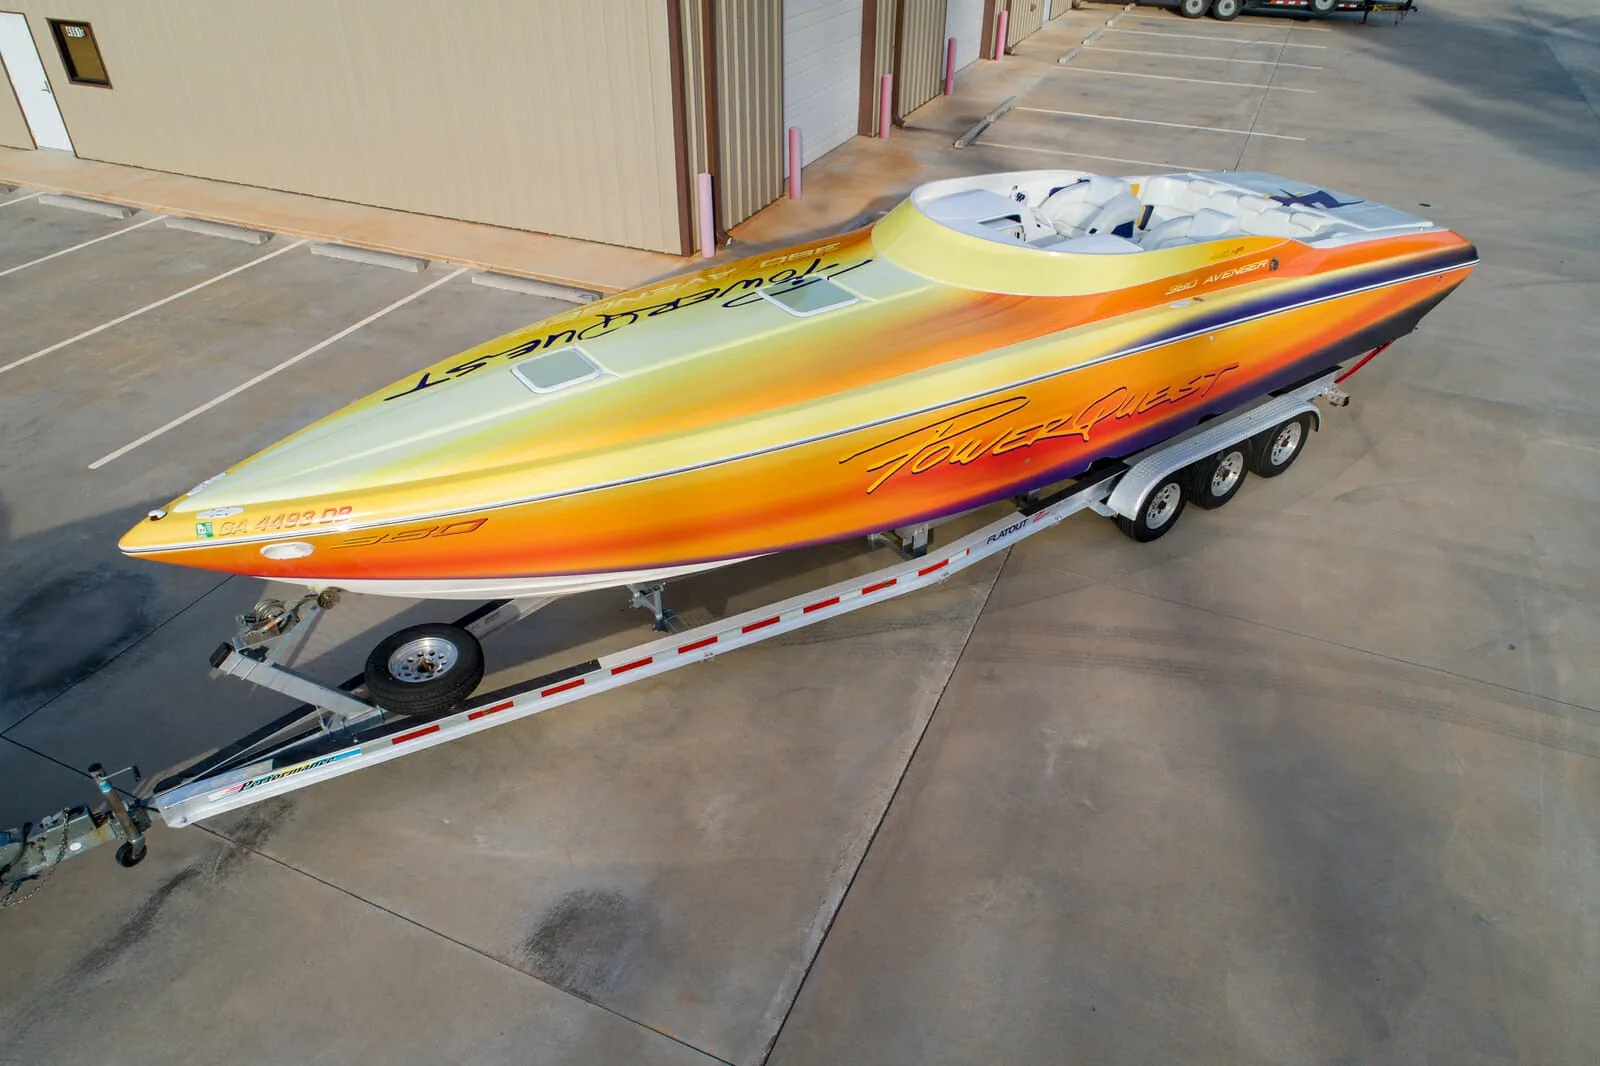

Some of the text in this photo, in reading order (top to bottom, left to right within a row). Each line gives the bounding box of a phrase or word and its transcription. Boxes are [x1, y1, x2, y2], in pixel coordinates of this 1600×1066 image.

[1203, 259, 1269, 284] AVENGER
[253, 510, 317, 532] 4493
[986, 518, 1028, 545] FLATOUT
